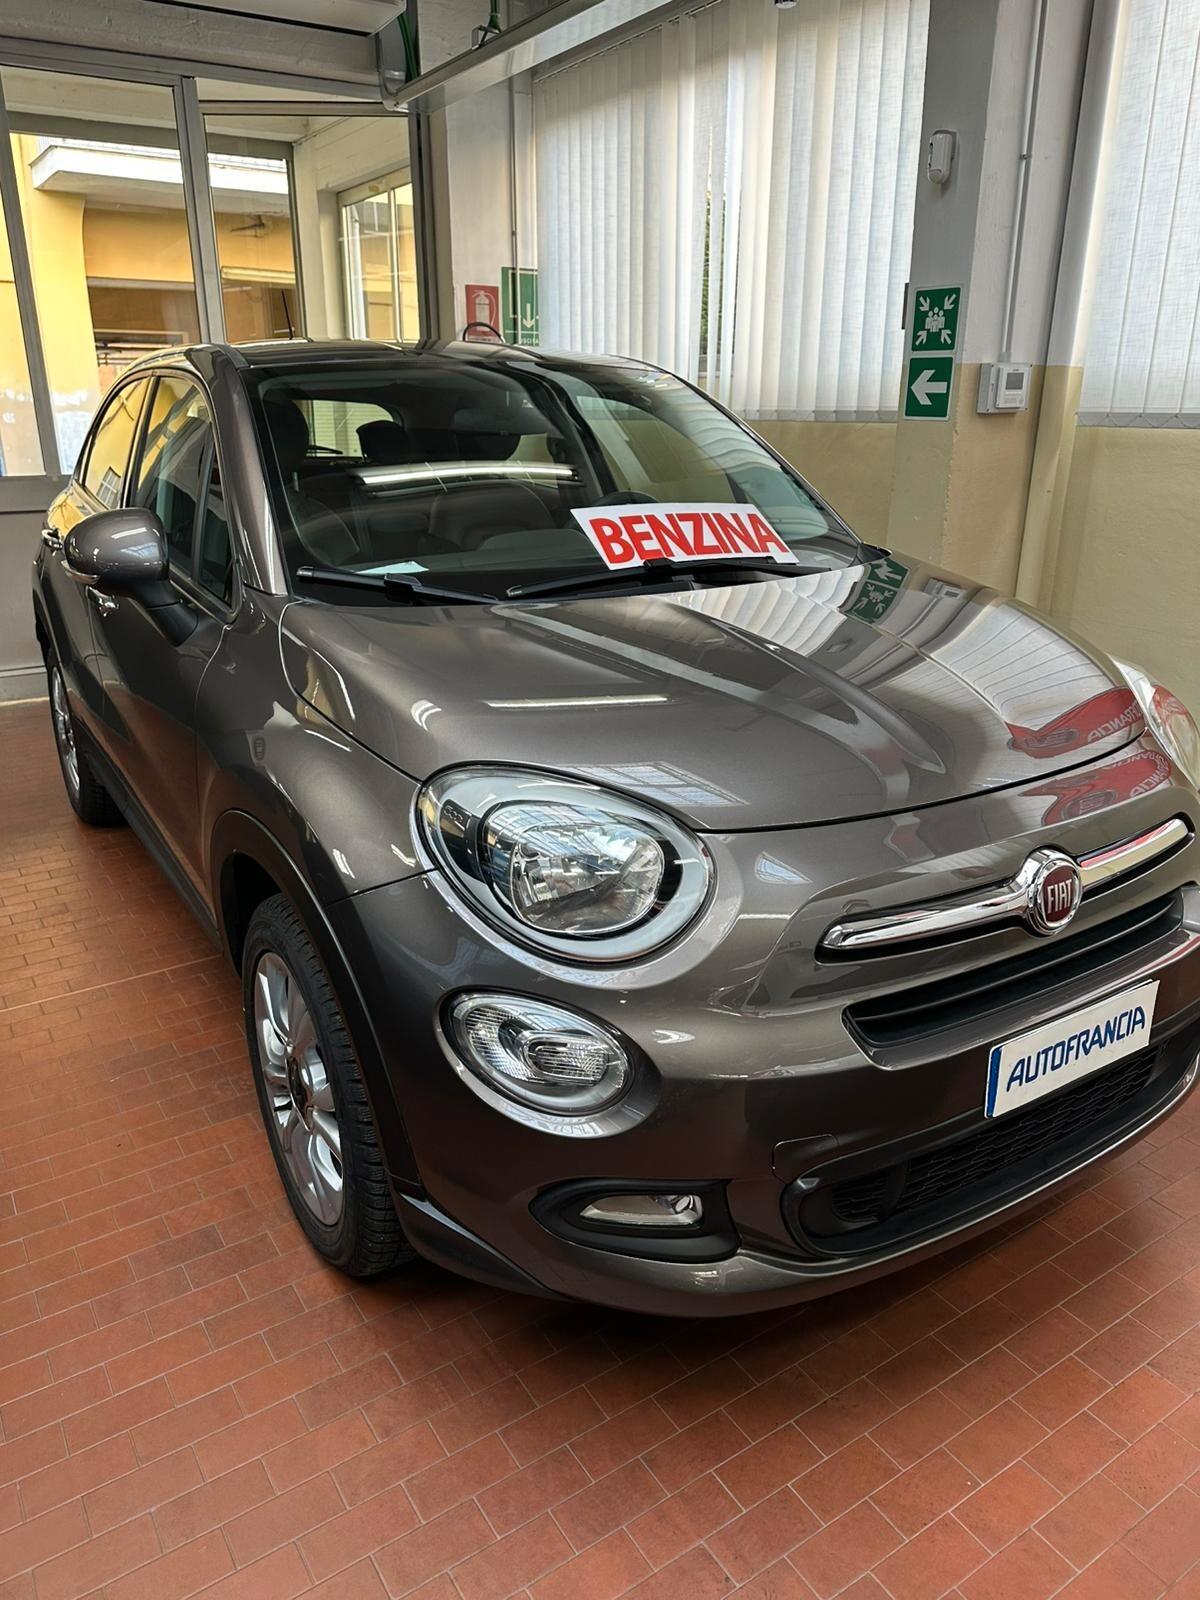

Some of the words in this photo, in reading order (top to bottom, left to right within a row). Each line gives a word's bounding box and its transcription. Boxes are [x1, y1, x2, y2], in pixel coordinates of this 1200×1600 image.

[589, 512, 790, 564] BENZINA
[1047, 879, 1073, 914] FIAT
[1006, 1005, 1146, 1093] AUTOFRANCIA
